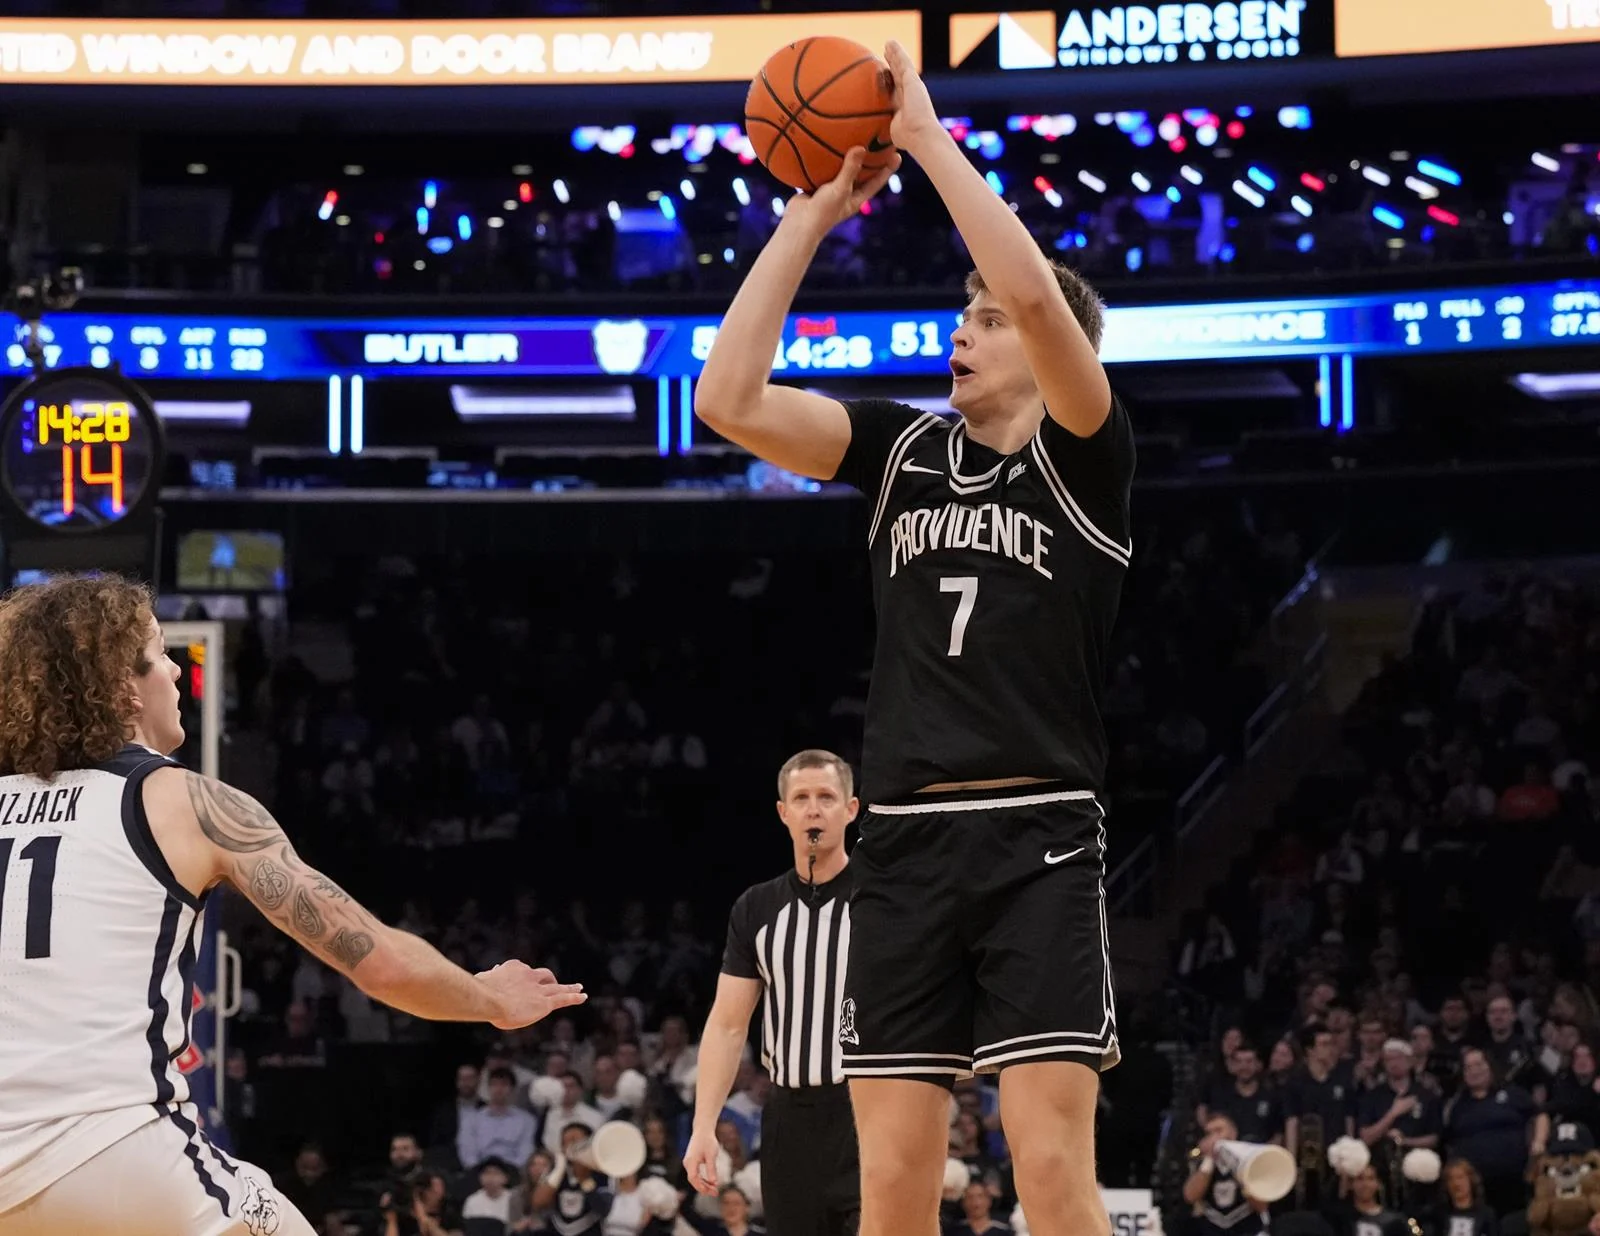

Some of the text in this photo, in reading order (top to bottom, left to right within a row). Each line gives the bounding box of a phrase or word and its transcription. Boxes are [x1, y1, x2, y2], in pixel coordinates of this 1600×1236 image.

[1058, 0, 1301, 49] ANDERSEN
[81, 34, 297, 74] WINDOW
[300, 35, 404, 74] AND
[411, 34, 547, 74] DOOR
[553, 32, 713, 72] BRAND
[364, 333, 518, 363] BUTLER
[890, 321, 943, 357] 51
[38, 402, 130, 445] 14:28
[62, 443, 123, 516] 14
[890, 501, 1054, 580] PROVIDENCE
[939, 576, 979, 657] 7
